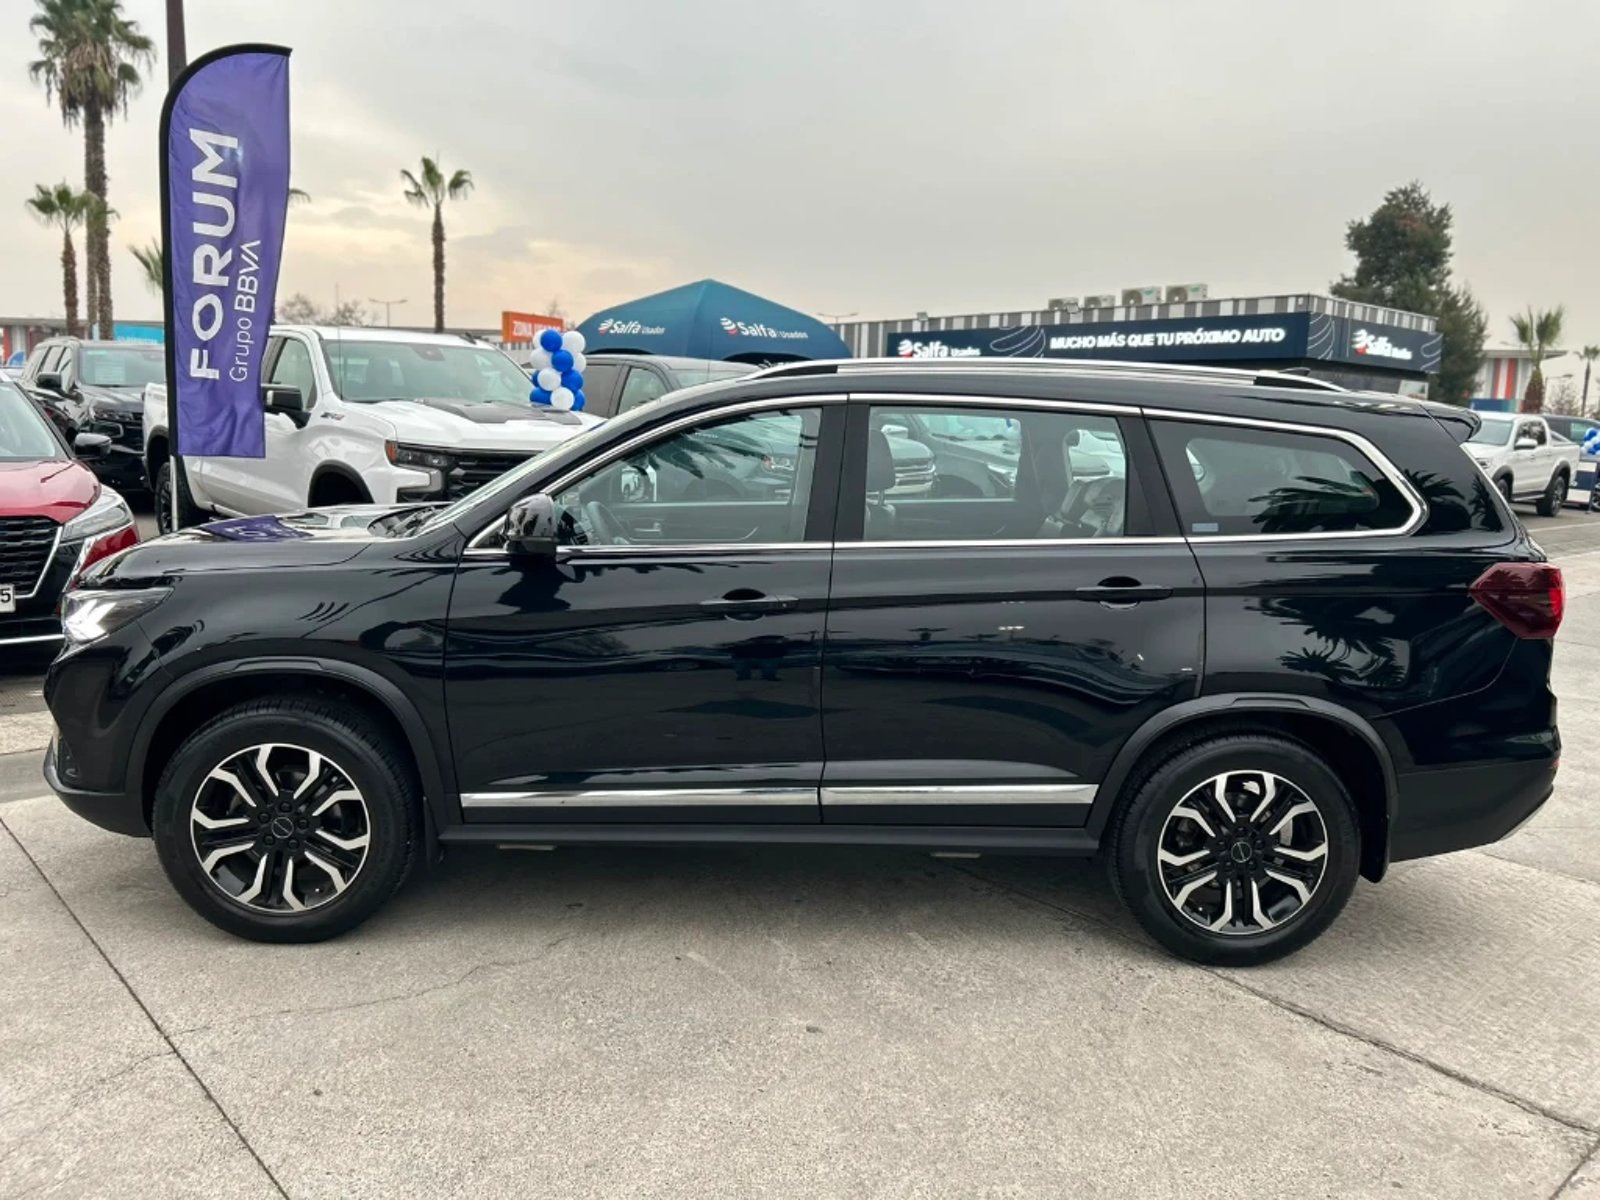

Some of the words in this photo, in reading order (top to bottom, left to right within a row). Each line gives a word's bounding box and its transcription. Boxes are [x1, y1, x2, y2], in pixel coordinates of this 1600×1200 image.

[189, 128, 239, 380] FORUM
[234, 240, 262, 313] BBVA
[609, 320, 641, 335] Salfa
[737, 321, 777, 338] Salfa
[1050, 335, 1096, 350] MUCHO
[1096, 331, 1126, 347] MÁS
[1127, 333, 1155, 348] QUE
[1156, 332, 1174, 346] TU
[1174, 327, 1241, 345] PRÓXIMO
[1241, 327, 1286, 343] AUTO
[229, 317, 255, 382] Grupo
[913, 341, 949, 358] Salfa
